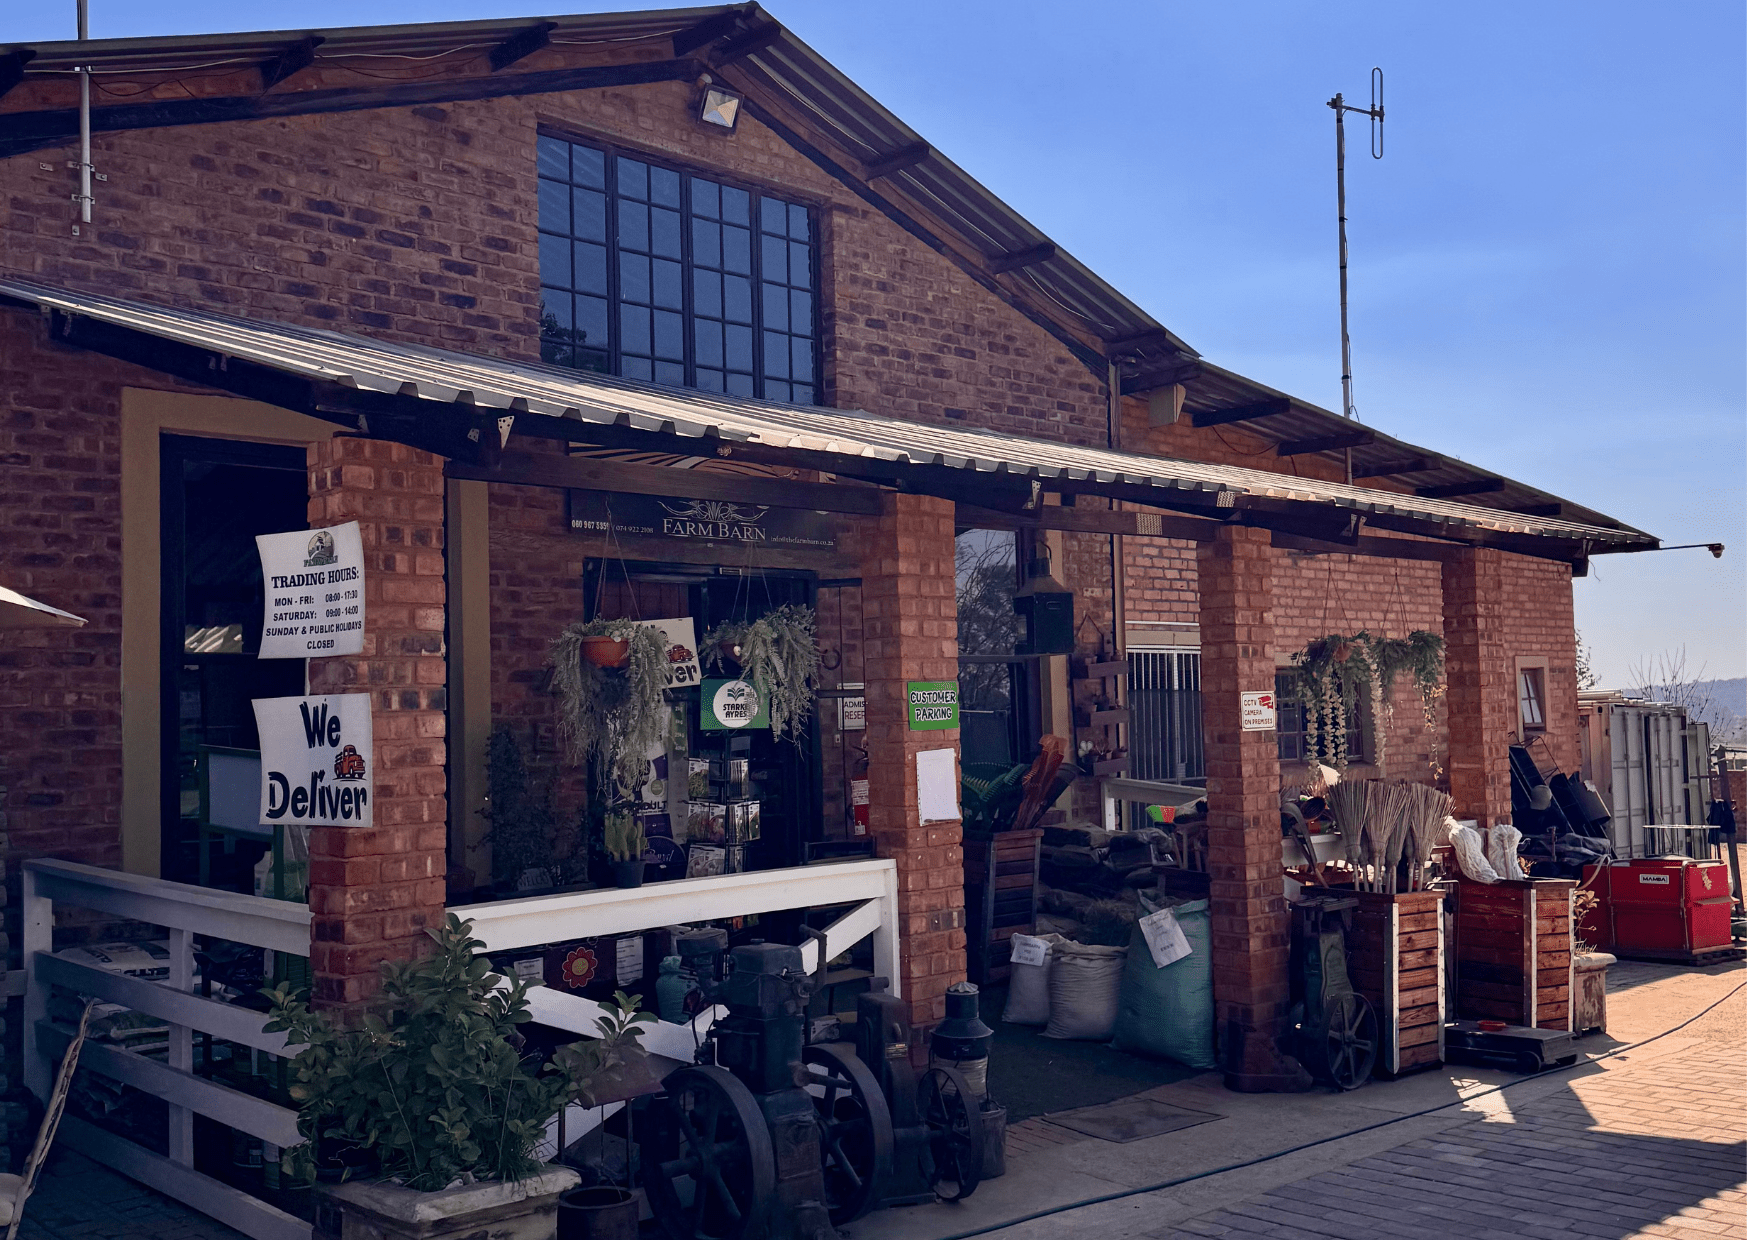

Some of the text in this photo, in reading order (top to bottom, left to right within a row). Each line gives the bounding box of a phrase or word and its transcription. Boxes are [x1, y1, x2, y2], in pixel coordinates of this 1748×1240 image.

[663, 518, 766, 541] FARM BARN
[271, 566, 360, 588] TRADING HOURS:
[274, 597, 292, 606] MON
[300, 596, 314, 605] FRI:
[325, 592, 340, 602] 08:00
[344, 590, 358, 600] 17:30
[273, 610, 316, 622] SATURDAY:
[326, 608, 340, 618] 09:00
[345, 605, 358, 616] 14:00
[266, 620, 362, 636] SUNDAY & PUBLIC HOLIDAYS
[307, 640, 334, 650] CLOSED
[910, 690, 956, 704] CUSTOMER
[915, 707, 952, 721] PARKING
[299, 701, 341, 749] We
[266, 770, 367, 820] Deliver
